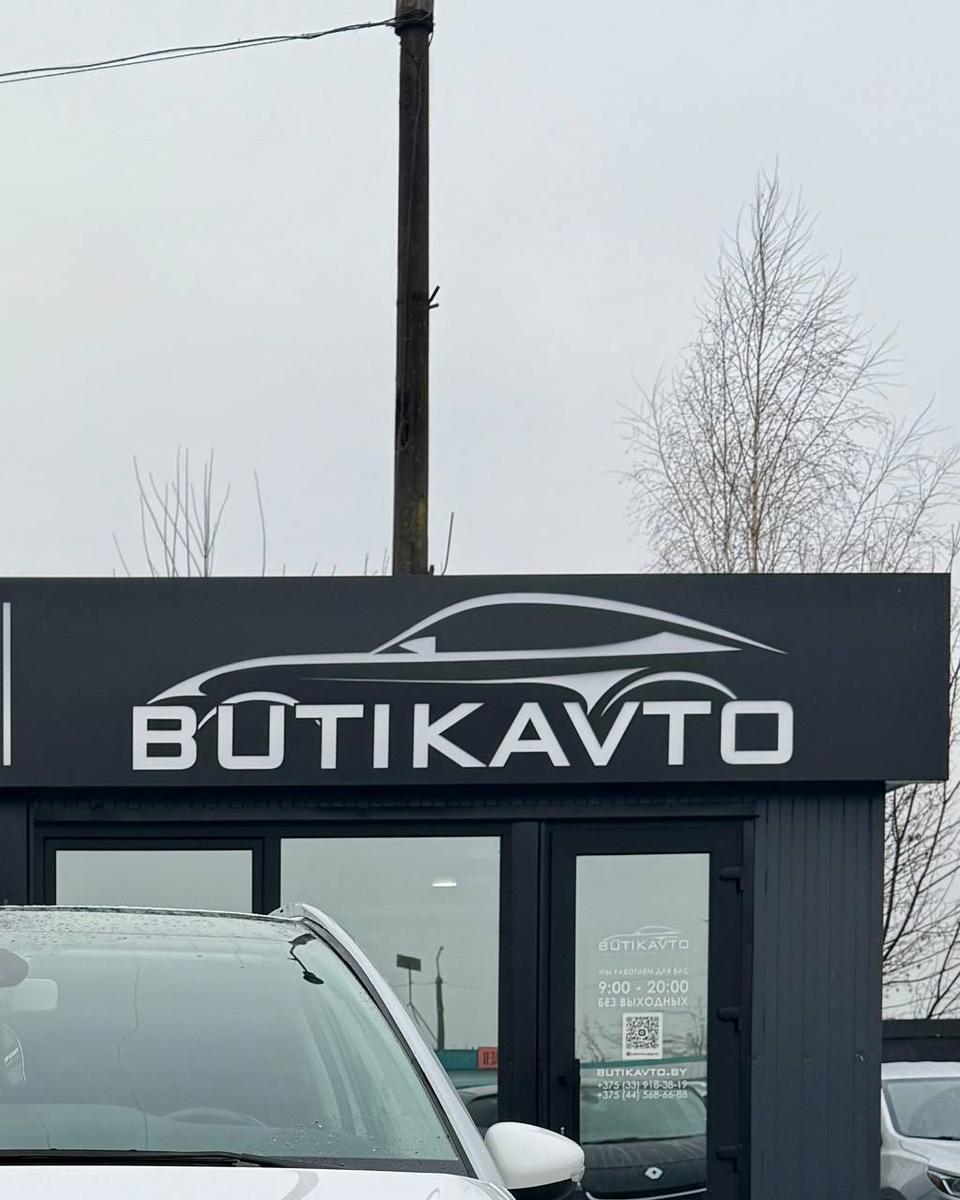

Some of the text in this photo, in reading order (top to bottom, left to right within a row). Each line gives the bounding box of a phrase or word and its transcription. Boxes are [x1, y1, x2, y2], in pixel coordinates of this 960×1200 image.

[132, 700, 795, 771] BUTIKAVTO
[598, 939, 689, 951] BUTIKAVTO
[598, 981, 631, 995] 9:00
[647, 980, 689, 994] 20:00
[598, 996, 689, 1008] БЕЗ ВЫХОДНЫХ
[596, 1068, 688, 1077] BUTIKAVTO.BY
[598, 1081, 620, 1090] +375
[642, 1080, 688, 1090] 918-38-19
[622, 1090, 640, 1101] (44)
